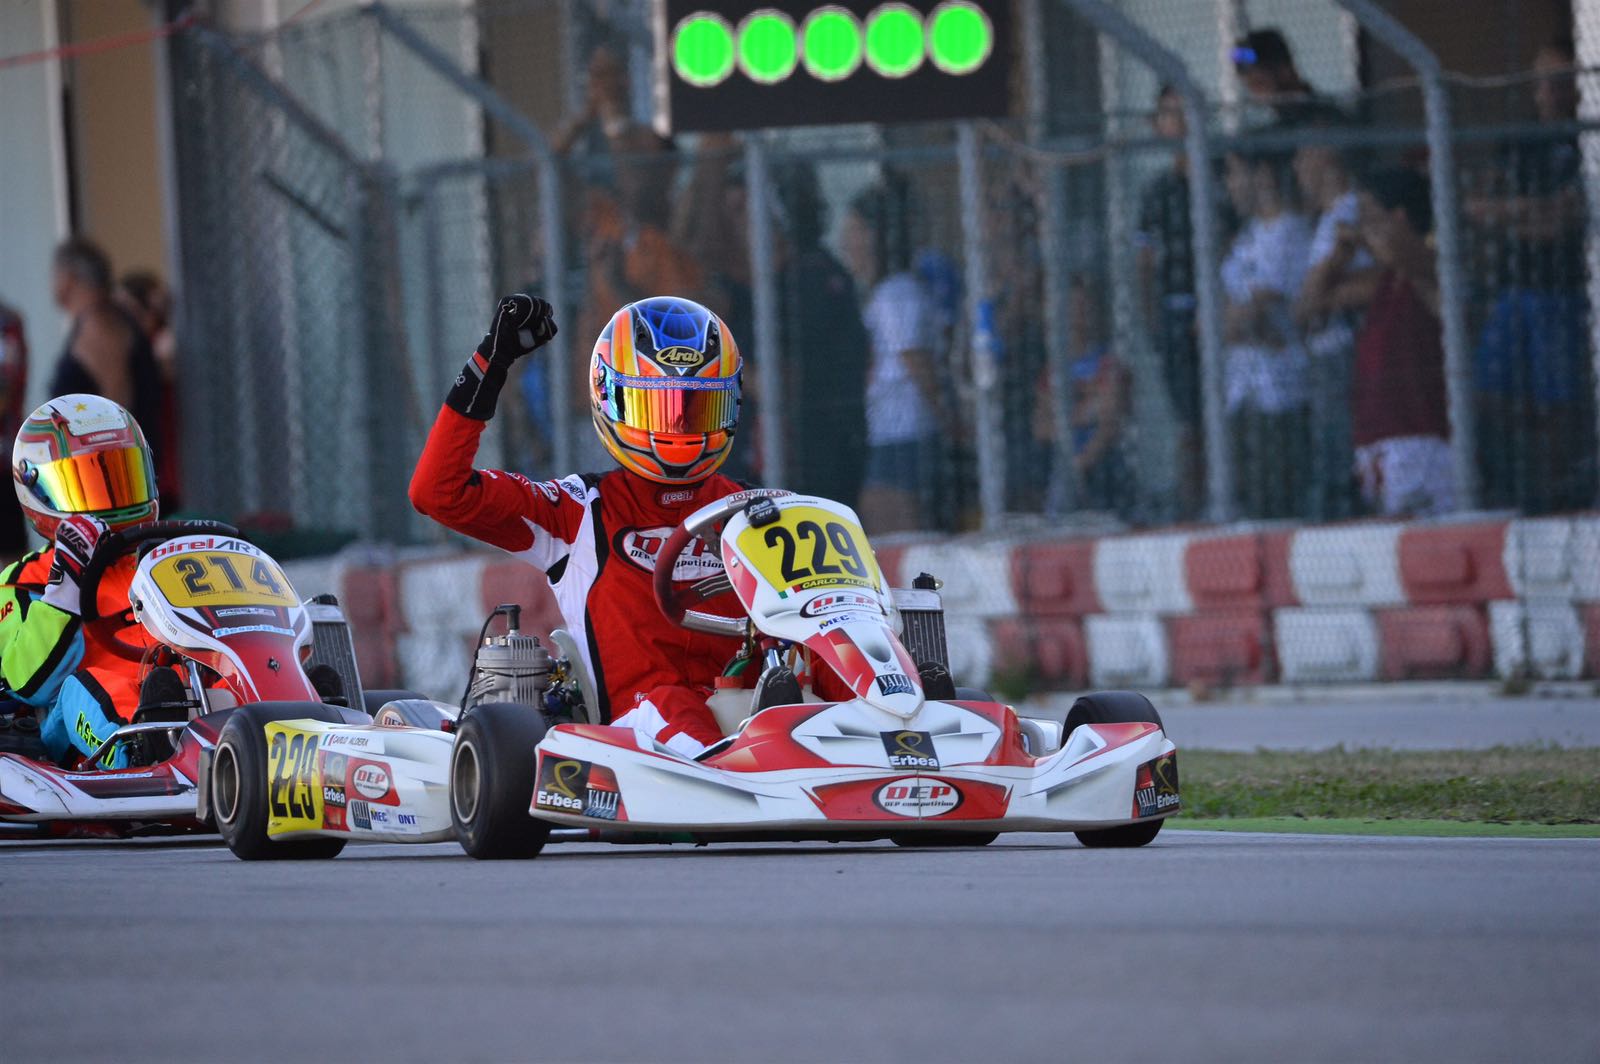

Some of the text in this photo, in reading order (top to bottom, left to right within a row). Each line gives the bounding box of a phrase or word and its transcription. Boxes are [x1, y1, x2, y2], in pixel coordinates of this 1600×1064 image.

[660, 347, 699, 362] Arai
[764, 521, 868, 583] 229
[173, 554, 286, 598] 214
[802, 578, 838, 589] CARLO
[889, 755, 938, 768] Erbea
[271, 732, 318, 820] 229
[356, 769, 386, 785] DEP
[323, 787, 345, 803] Erbea
[536, 790, 582, 810] Erbea
[587, 789, 618, 811] VALLI
[886, 786, 951, 799] DEP
[1156, 793, 1179, 809] Erbea
